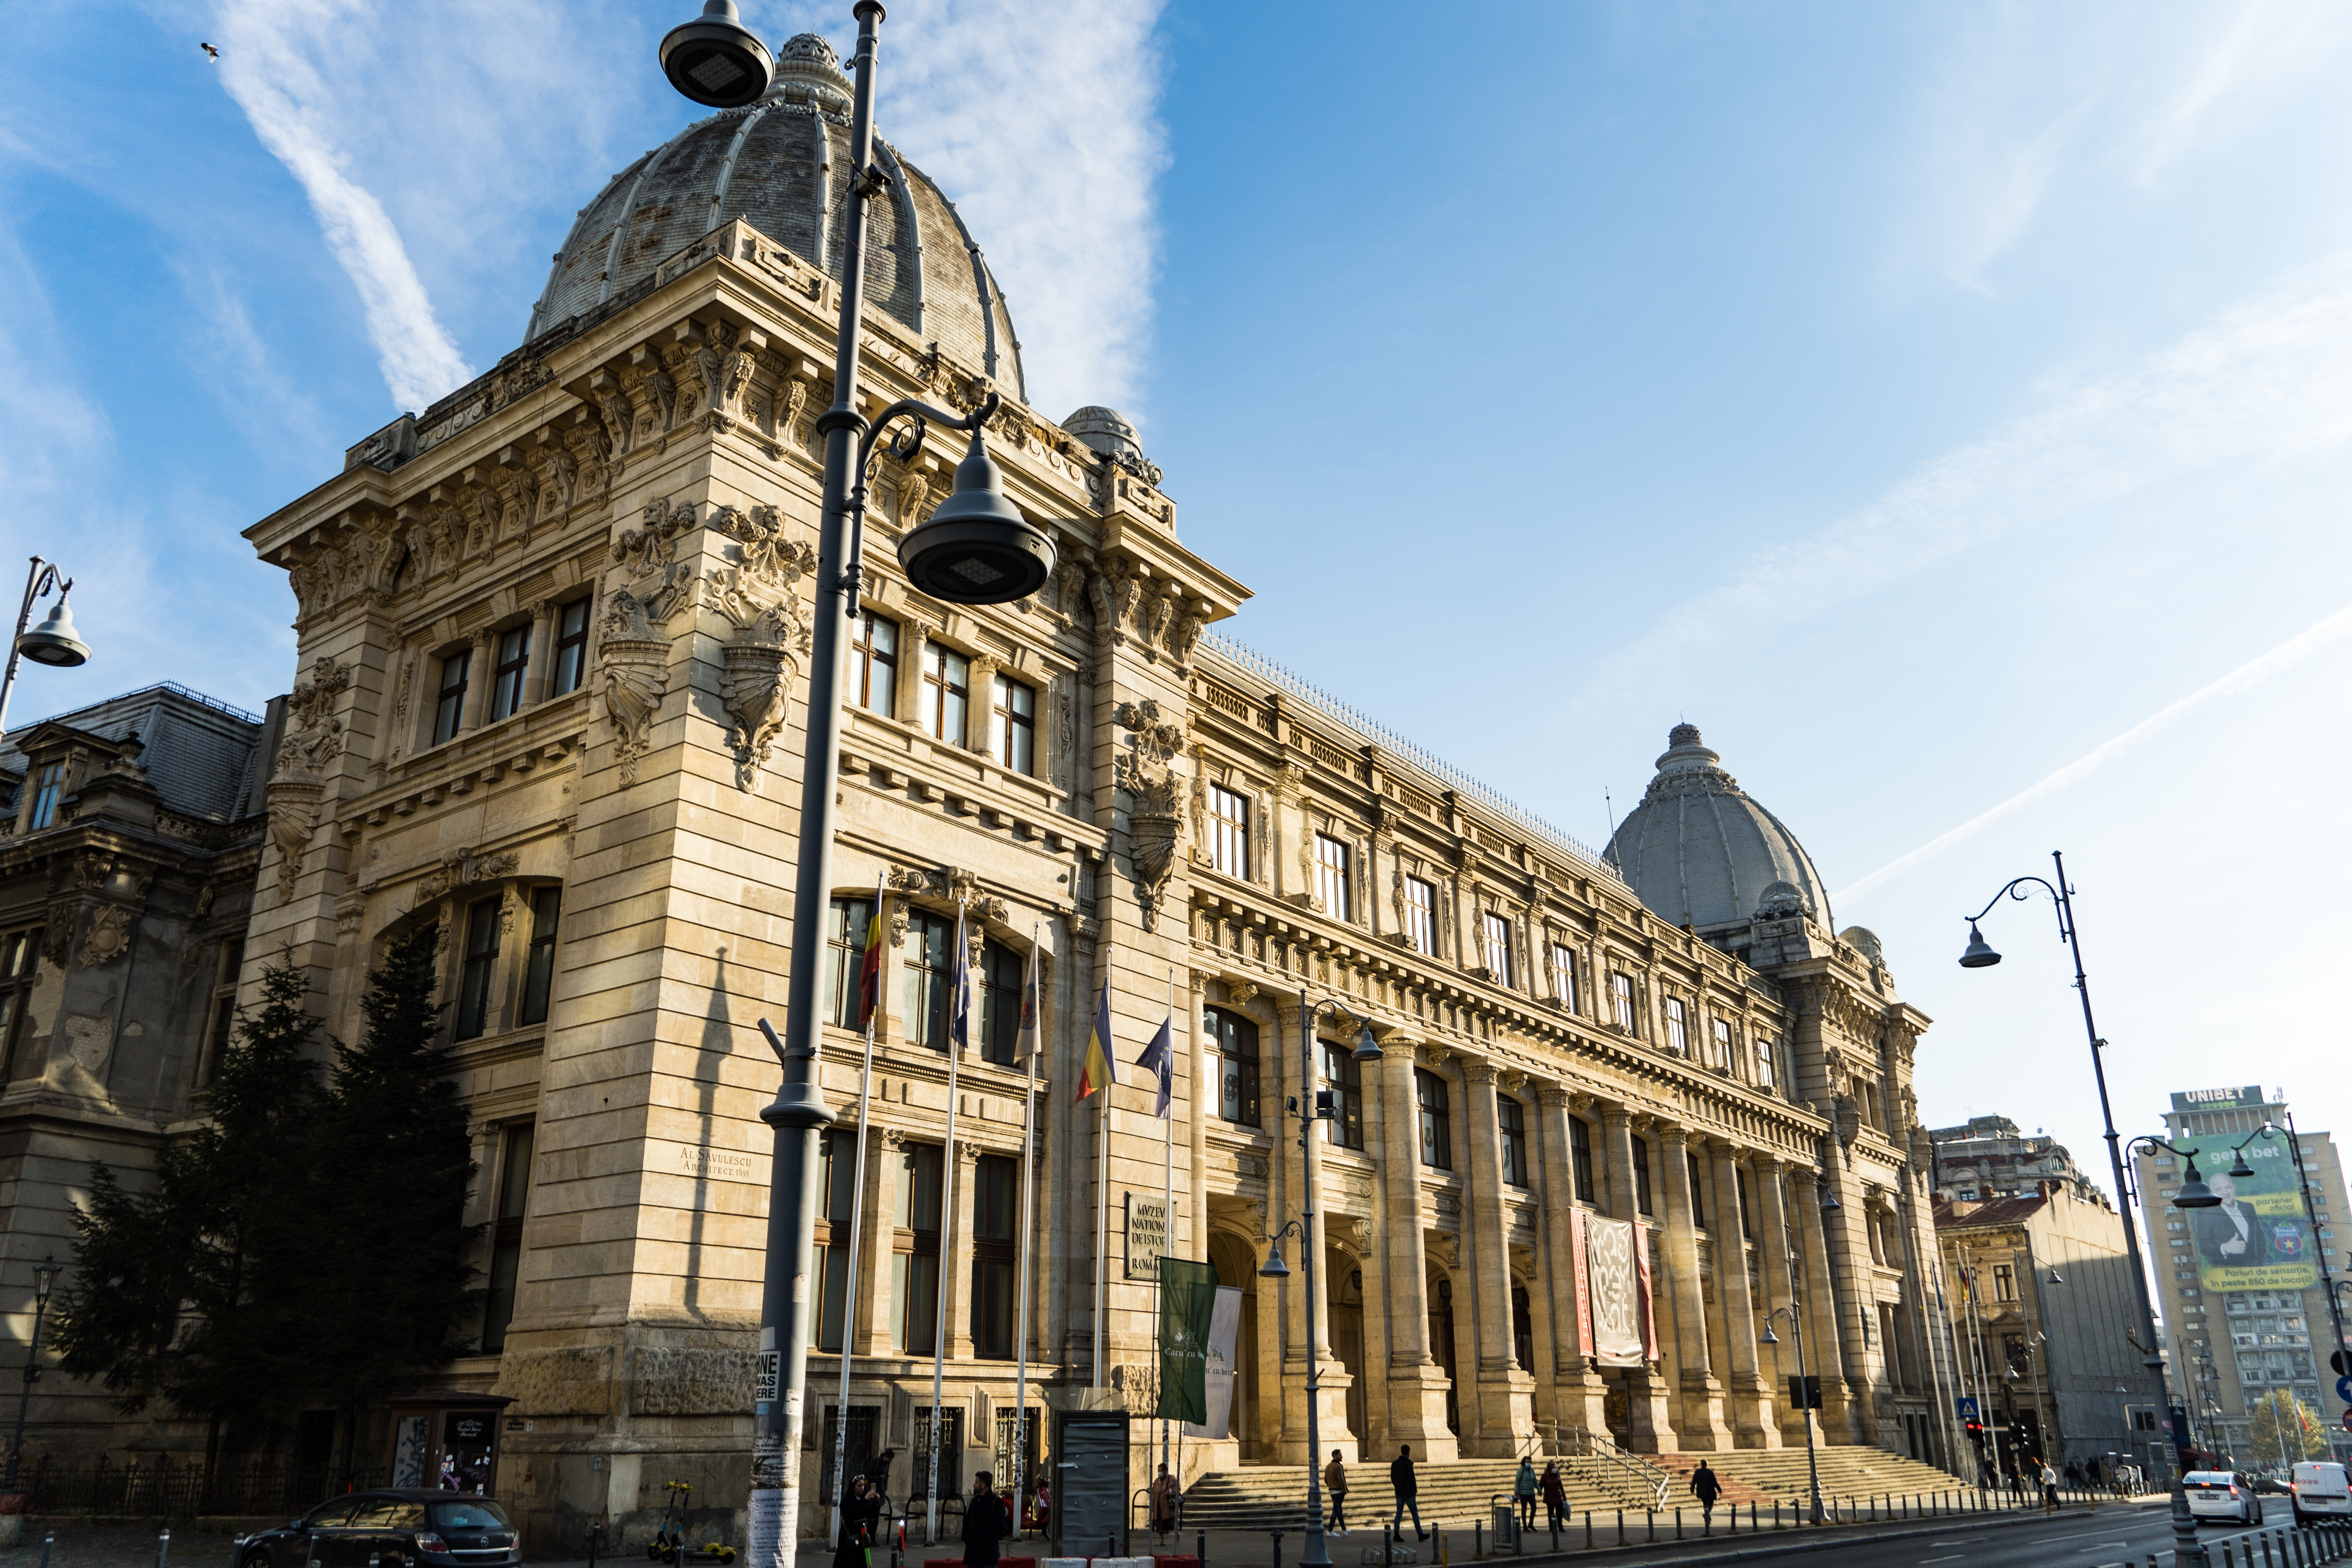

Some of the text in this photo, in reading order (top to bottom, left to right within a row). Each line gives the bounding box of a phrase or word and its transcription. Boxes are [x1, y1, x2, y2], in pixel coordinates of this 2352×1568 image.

[2185, 1087, 2245, 1103] UNIBET
[698, 1148, 751, 1167] SAVULESCU
[2252, 1146, 2279, 1158] bet
[736, 1169, 749, 1177] 1899
[1132, 1218, 1174, 1233] NATIONL
[1132, 1232, 1143, 1244] DE
[2221, 1279, 2246, 1289] peste
